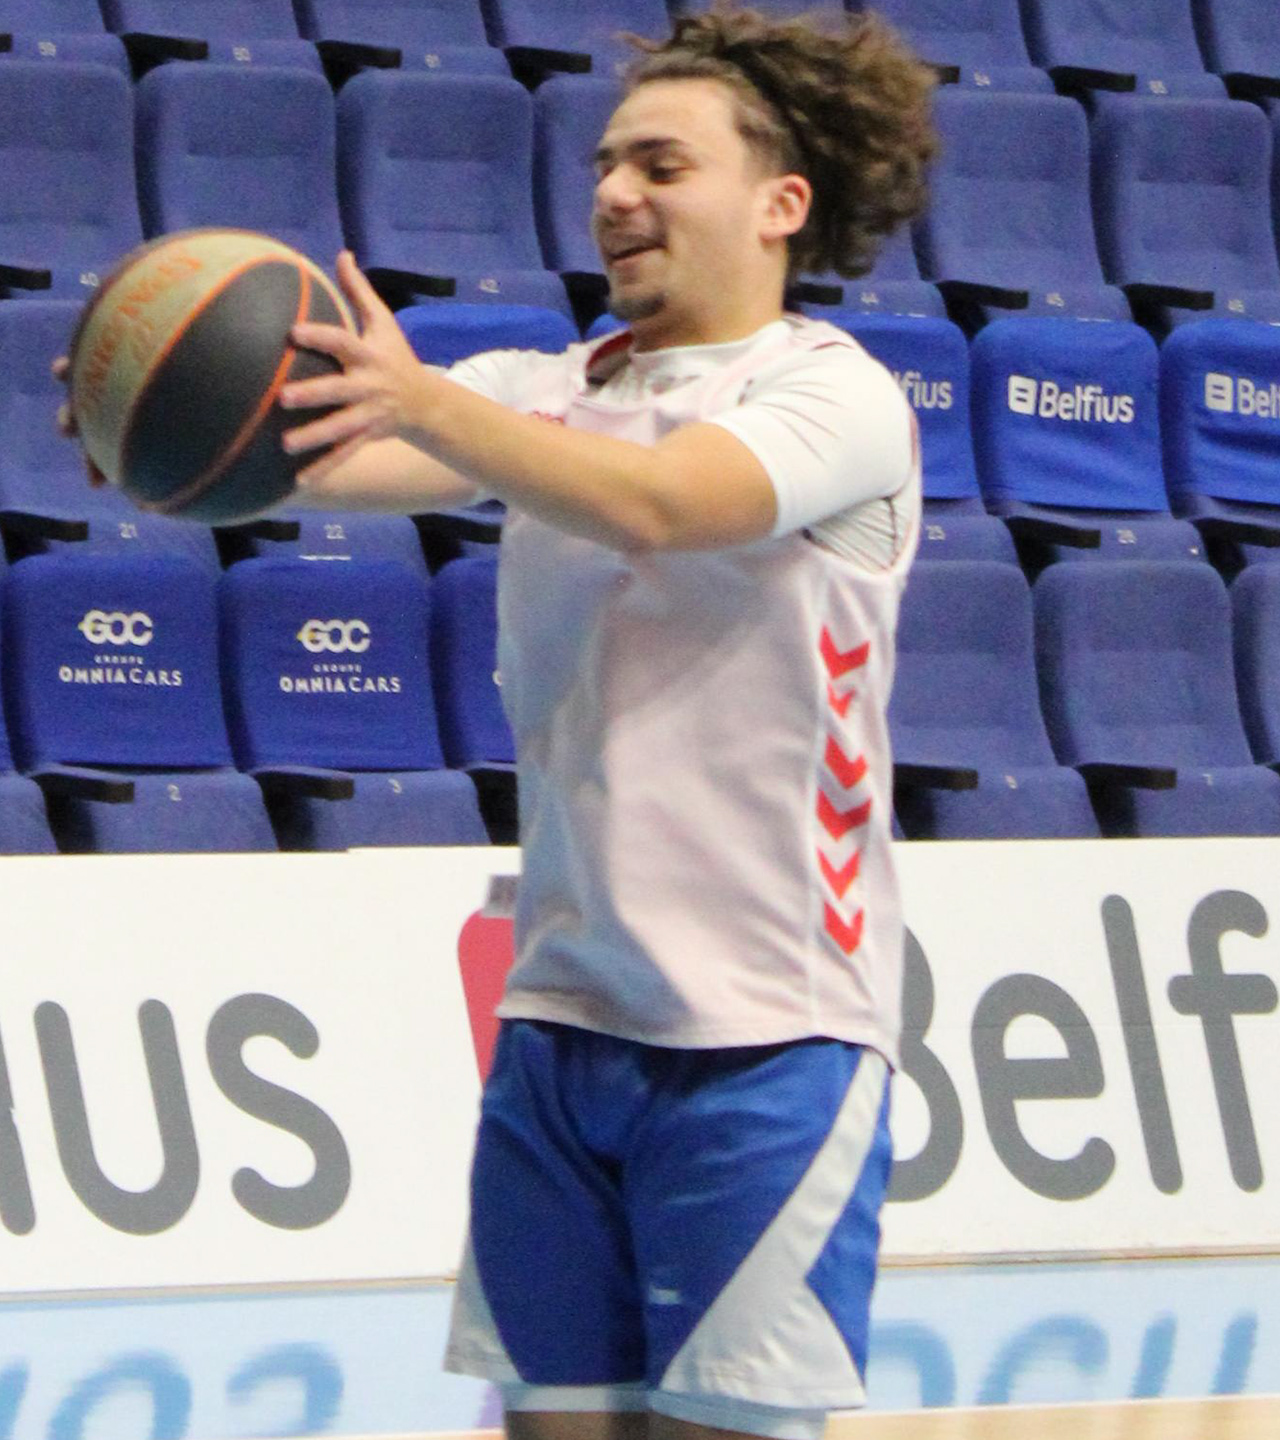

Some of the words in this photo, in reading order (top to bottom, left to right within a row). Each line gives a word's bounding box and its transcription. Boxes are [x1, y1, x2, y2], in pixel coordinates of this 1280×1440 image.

[1038, 380, 1135, 424] Belfius
[81, 610, 153, 646] GOC
[300, 619, 370, 653] GOC
